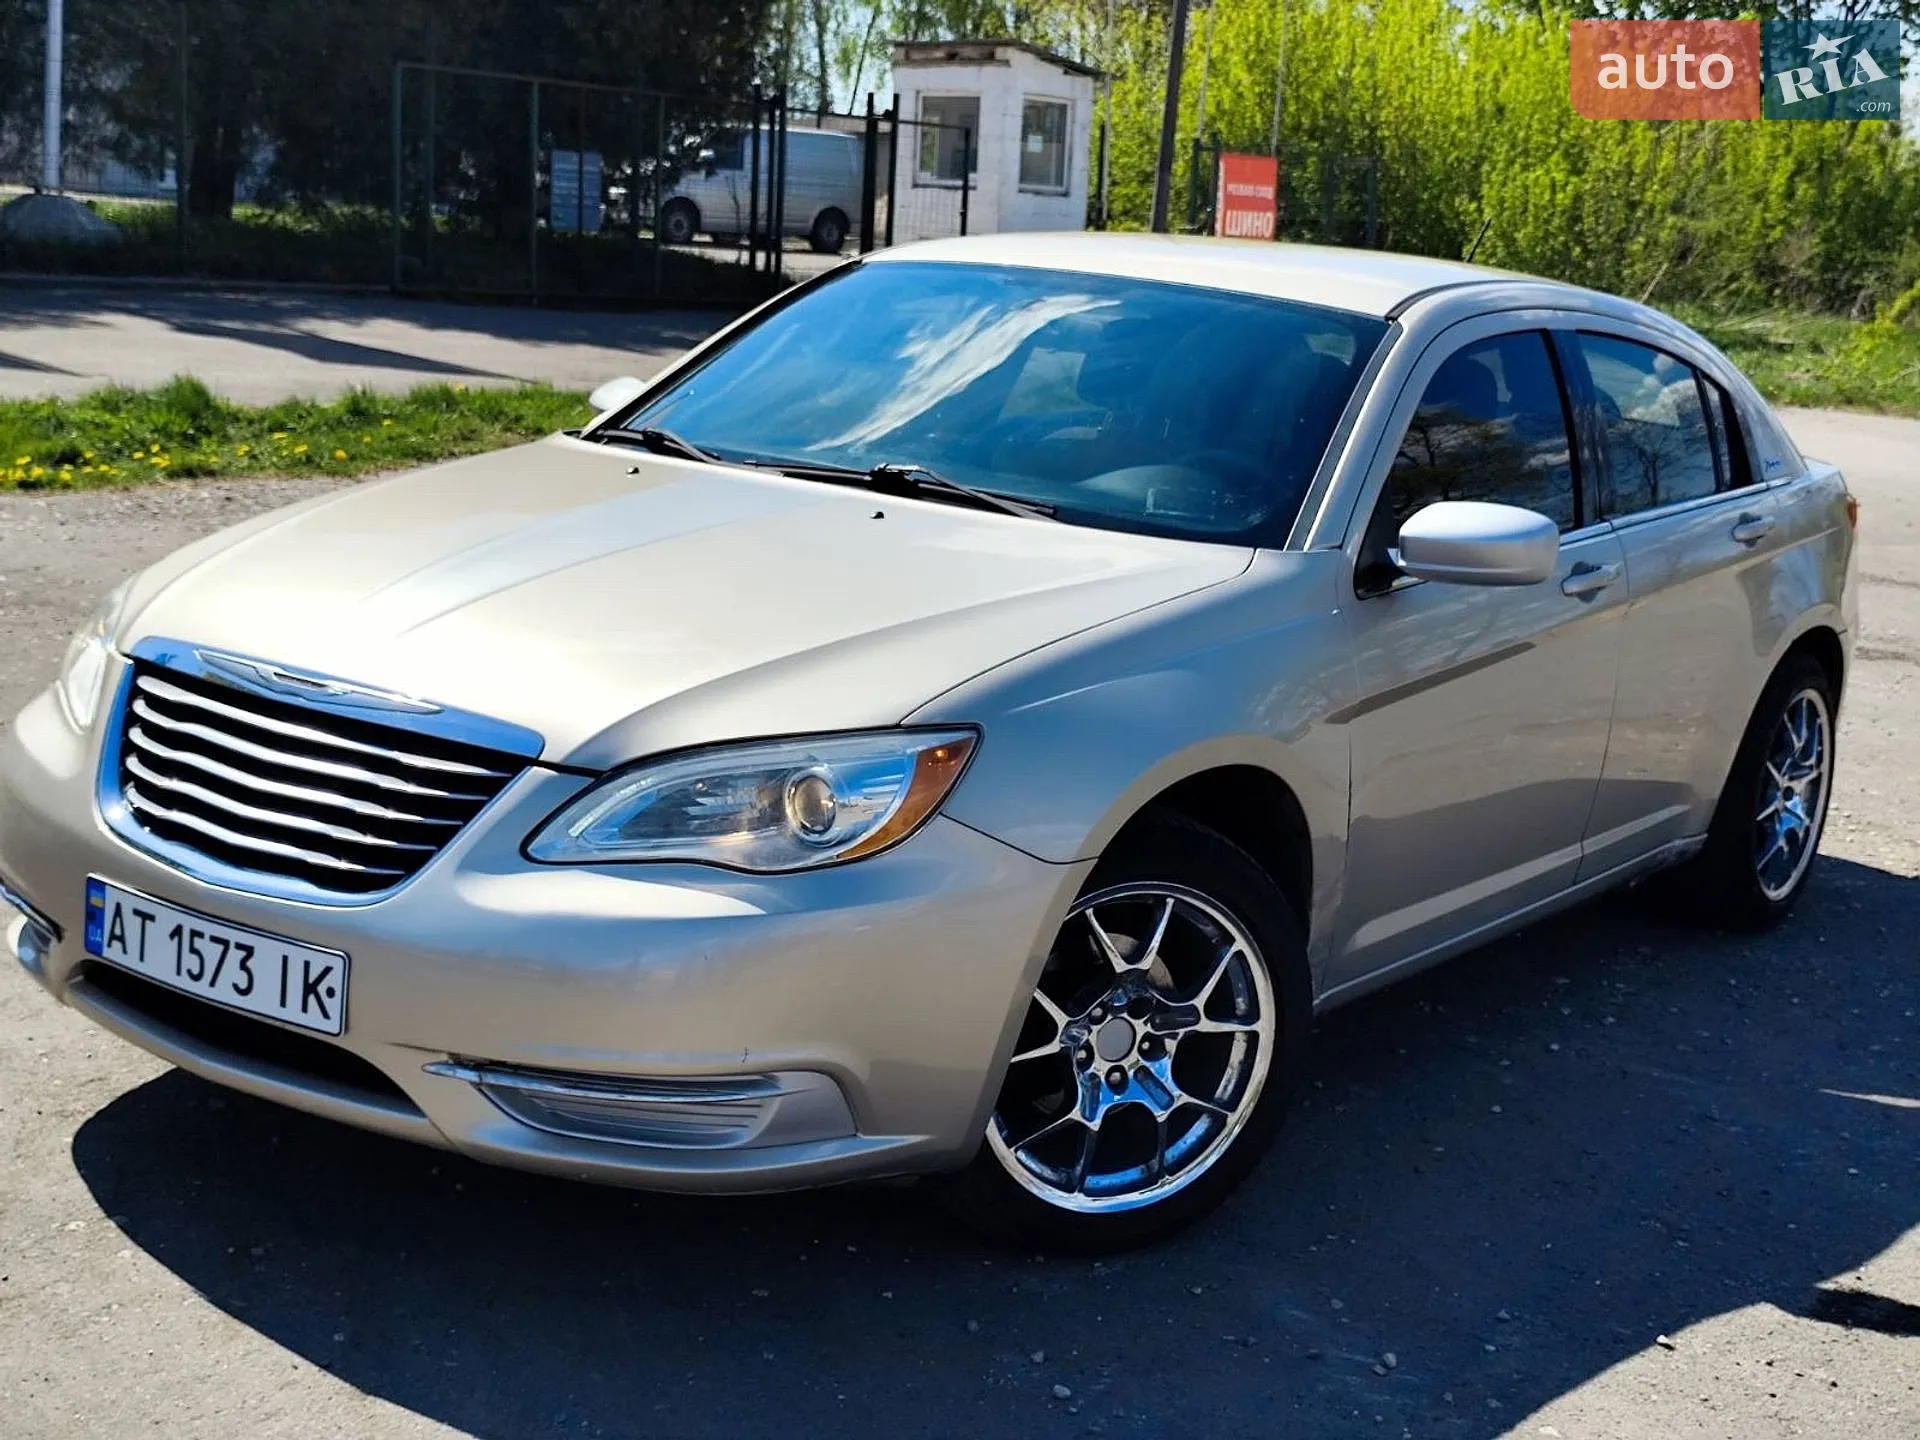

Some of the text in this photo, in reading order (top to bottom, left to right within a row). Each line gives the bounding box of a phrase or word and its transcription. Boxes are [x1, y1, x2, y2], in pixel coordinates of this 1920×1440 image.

[1225, 210, 1275, 237] ШИНО
[107, 902, 155, 962] AT
[169, 923, 255, 996] 1573
